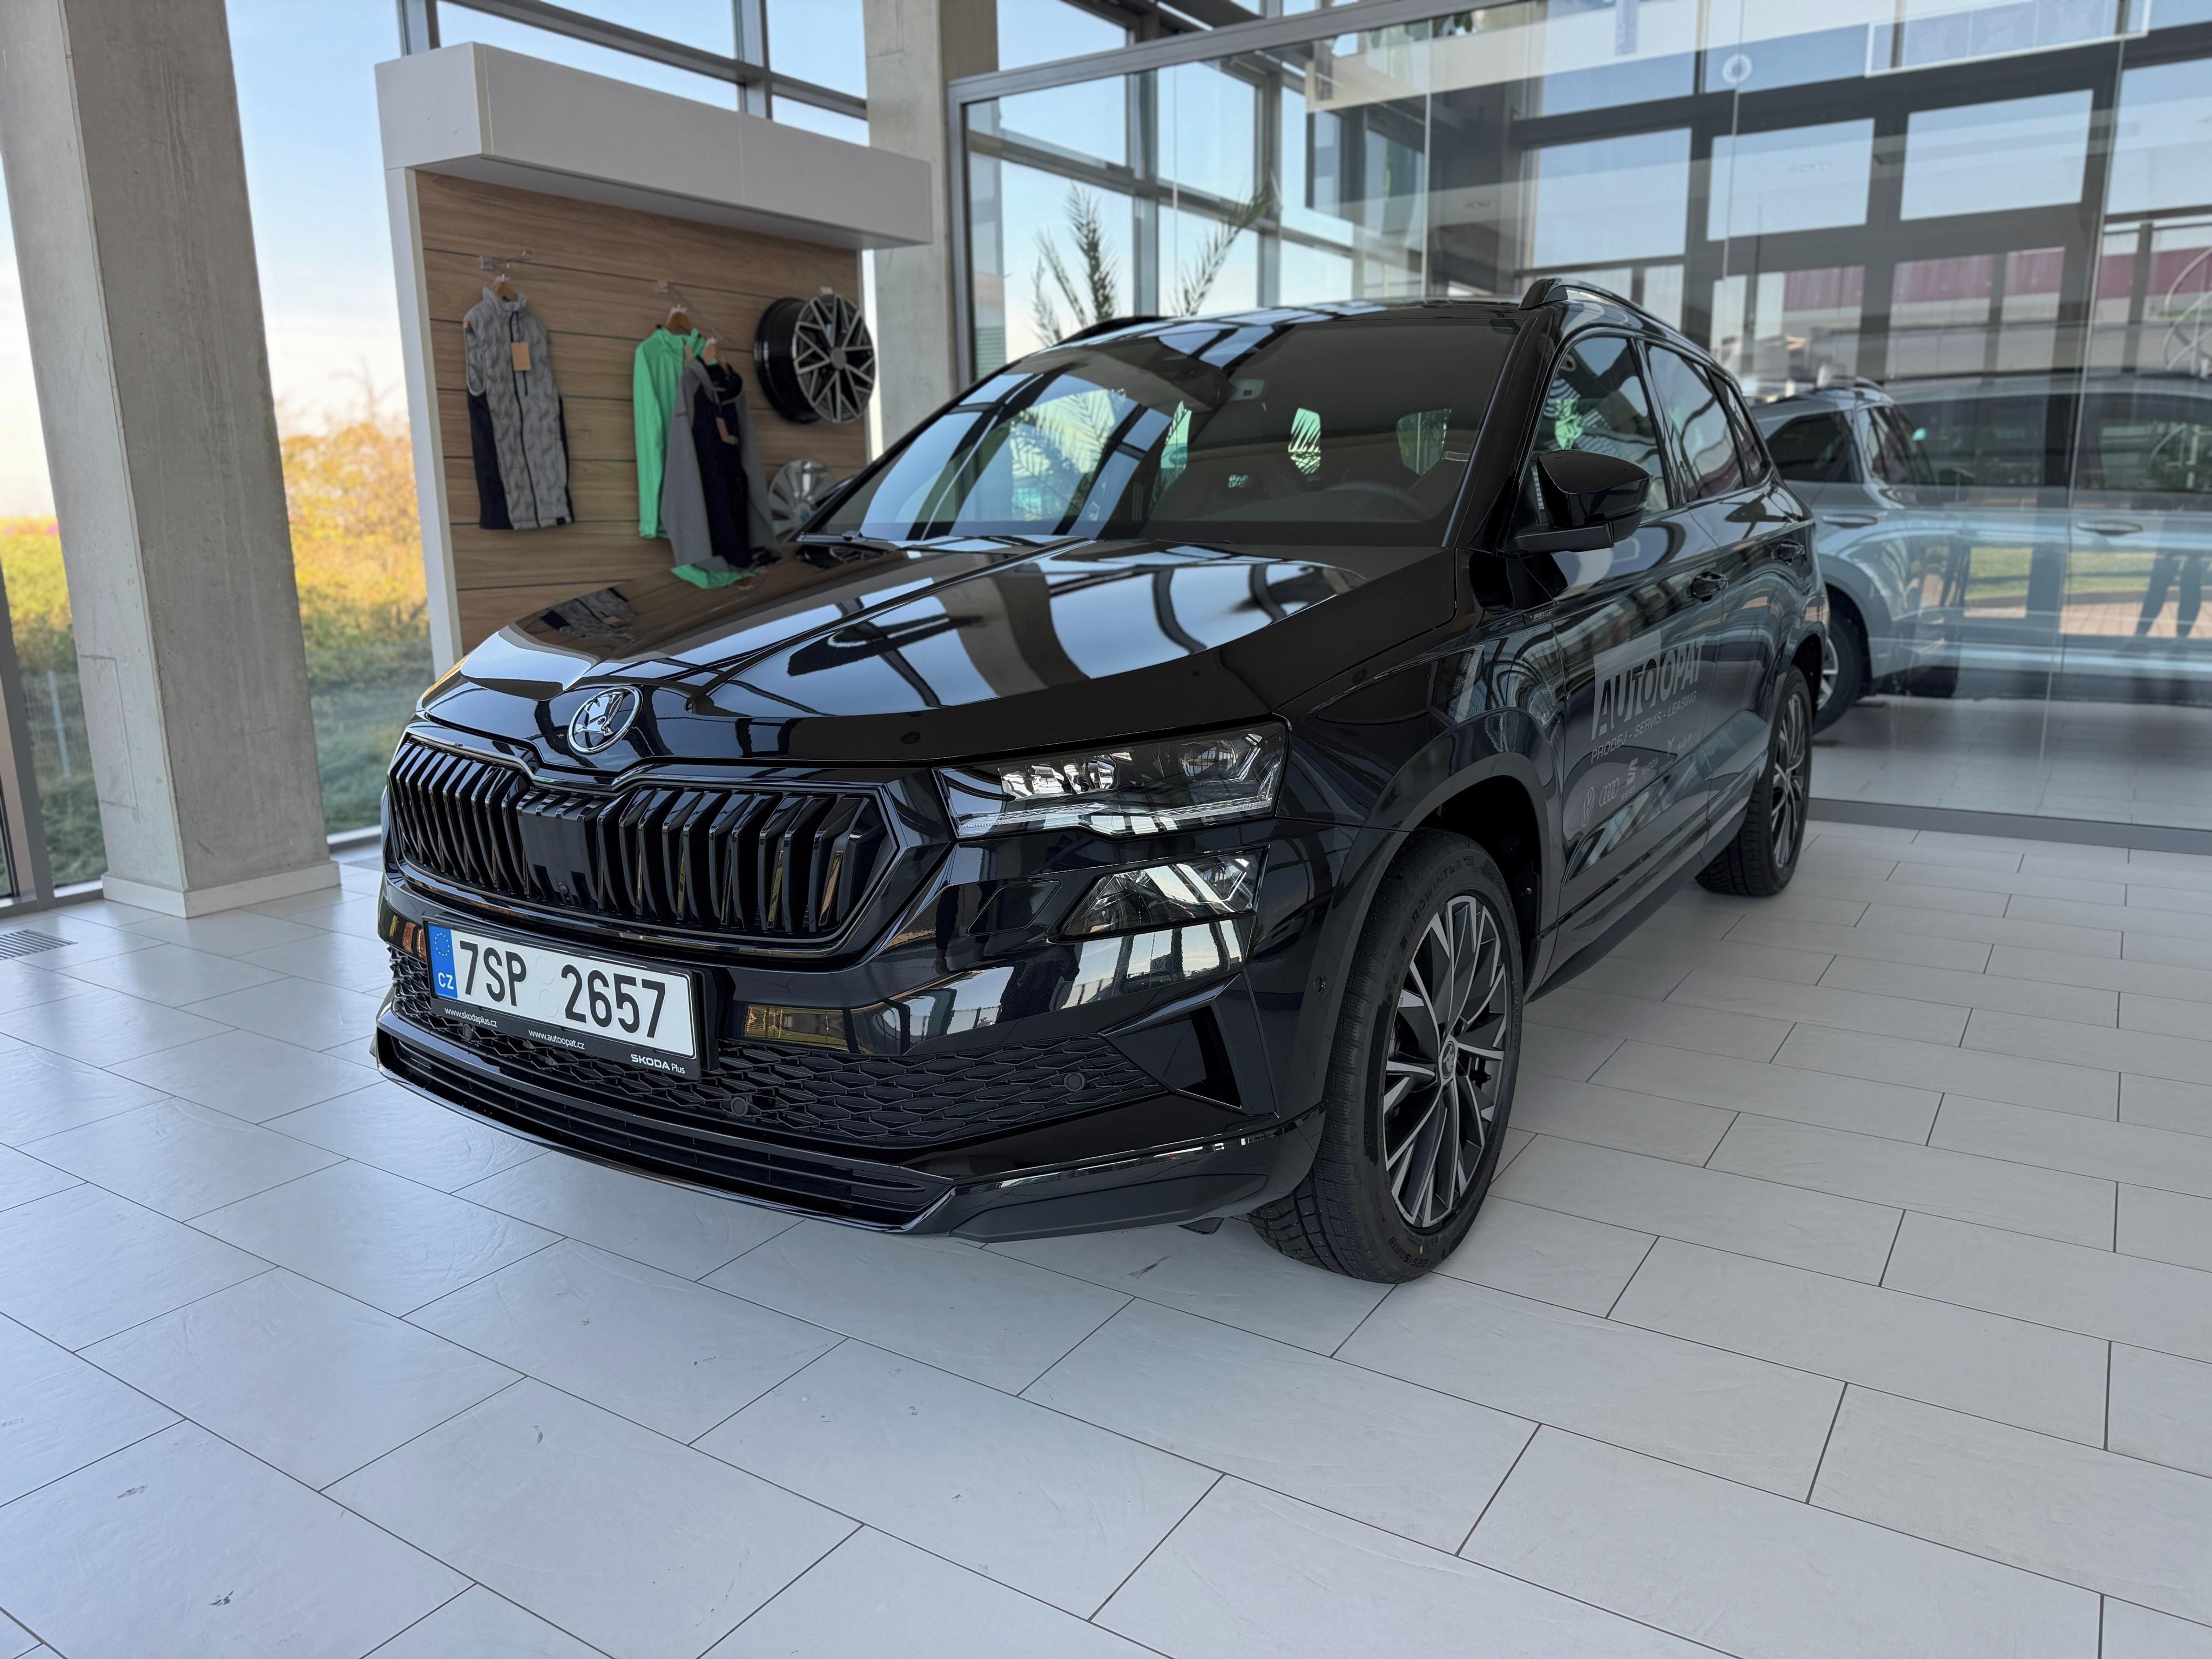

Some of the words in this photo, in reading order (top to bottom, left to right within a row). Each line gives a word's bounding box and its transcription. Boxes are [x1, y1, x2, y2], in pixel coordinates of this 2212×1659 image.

[1591, 731, 1628, 764] PRODEJ
[1634, 711, 1662, 738] SERVIS
[1668, 690, 1697, 718] LEASING
[1400, 860, 1462, 949] EUROWINTER
[438, 972, 454, 990] CZ
[460, 940, 527, 1007] 7SP
[561, 964, 666, 1038] 2657
[444, 1007, 498, 1028] www.skodaplus.cz
[528, 1029, 585, 1050] www.autoopat.cz
[671, 1063, 685, 1074] Plus
